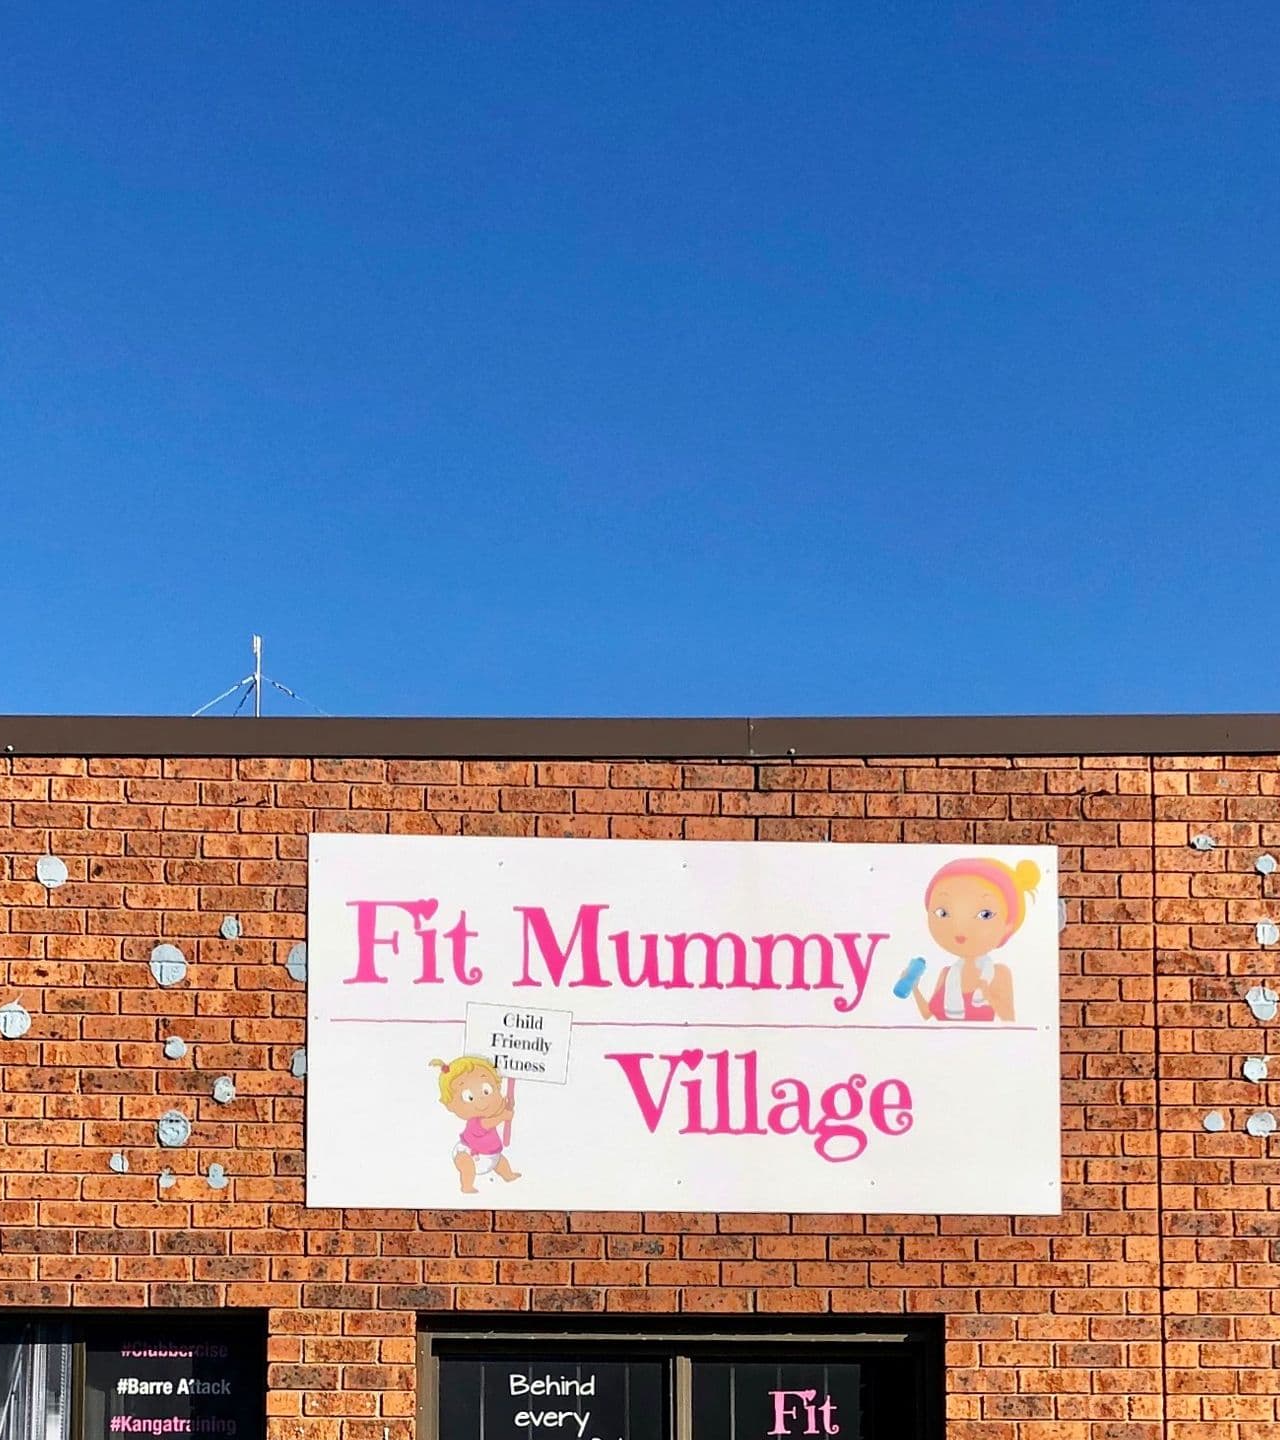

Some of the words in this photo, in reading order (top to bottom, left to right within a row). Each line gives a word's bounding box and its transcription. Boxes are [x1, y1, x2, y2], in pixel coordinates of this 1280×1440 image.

[342, 898, 483, 988] Fit
[511, 903, 890, 1011] Mummy
[503, 1012, 544, 1031] Child
[491, 1032, 552, 1056] Friendly
[492, 1054, 546, 1073] Fitness
[605, 1048, 914, 1163] Village
[116, 1377, 173, 1395] #Barre
[176, 1377, 232, 1395] Attack
[508, 1373, 596, 1396] Behind
[514, 1410, 590, 1438] every
[767, 1388, 840, 1436] Fit
